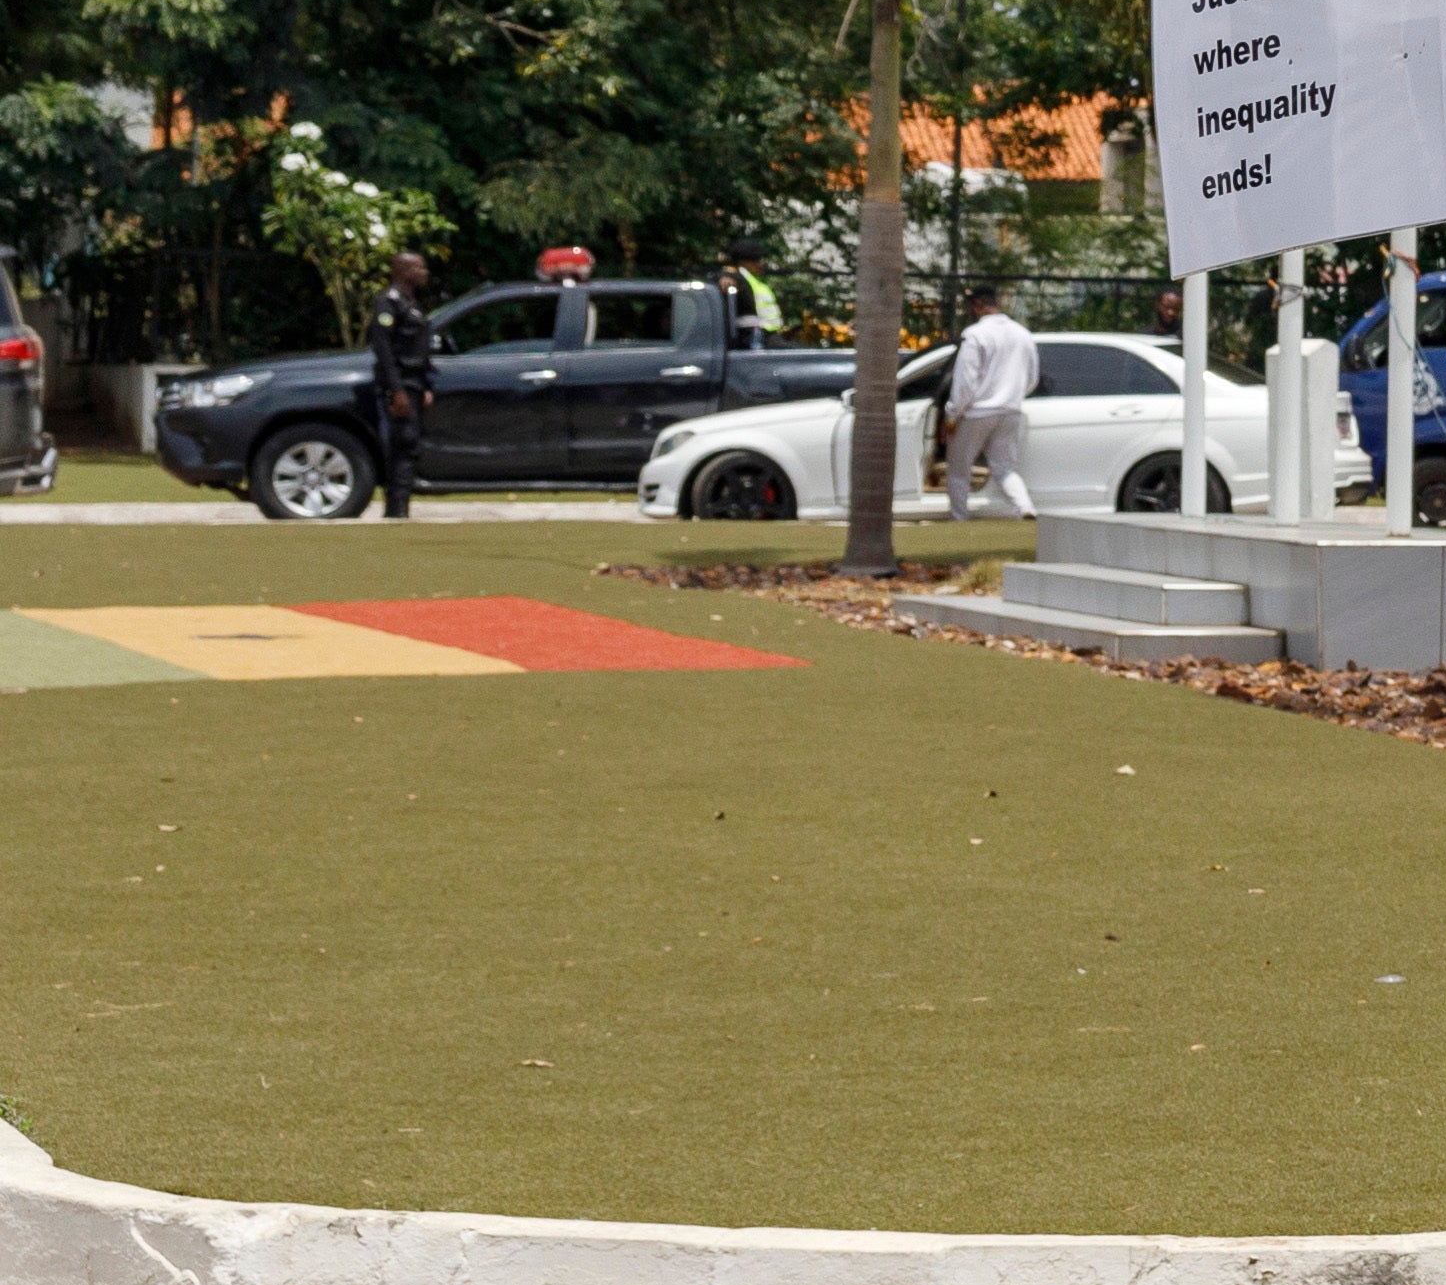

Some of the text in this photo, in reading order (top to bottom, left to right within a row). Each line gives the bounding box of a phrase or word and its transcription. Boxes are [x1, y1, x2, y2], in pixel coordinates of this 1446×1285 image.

[1193, 34, 1281, 76] where
[1197, 80, 1337, 138] inequality
[1202, 153, 1272, 200] ends!
